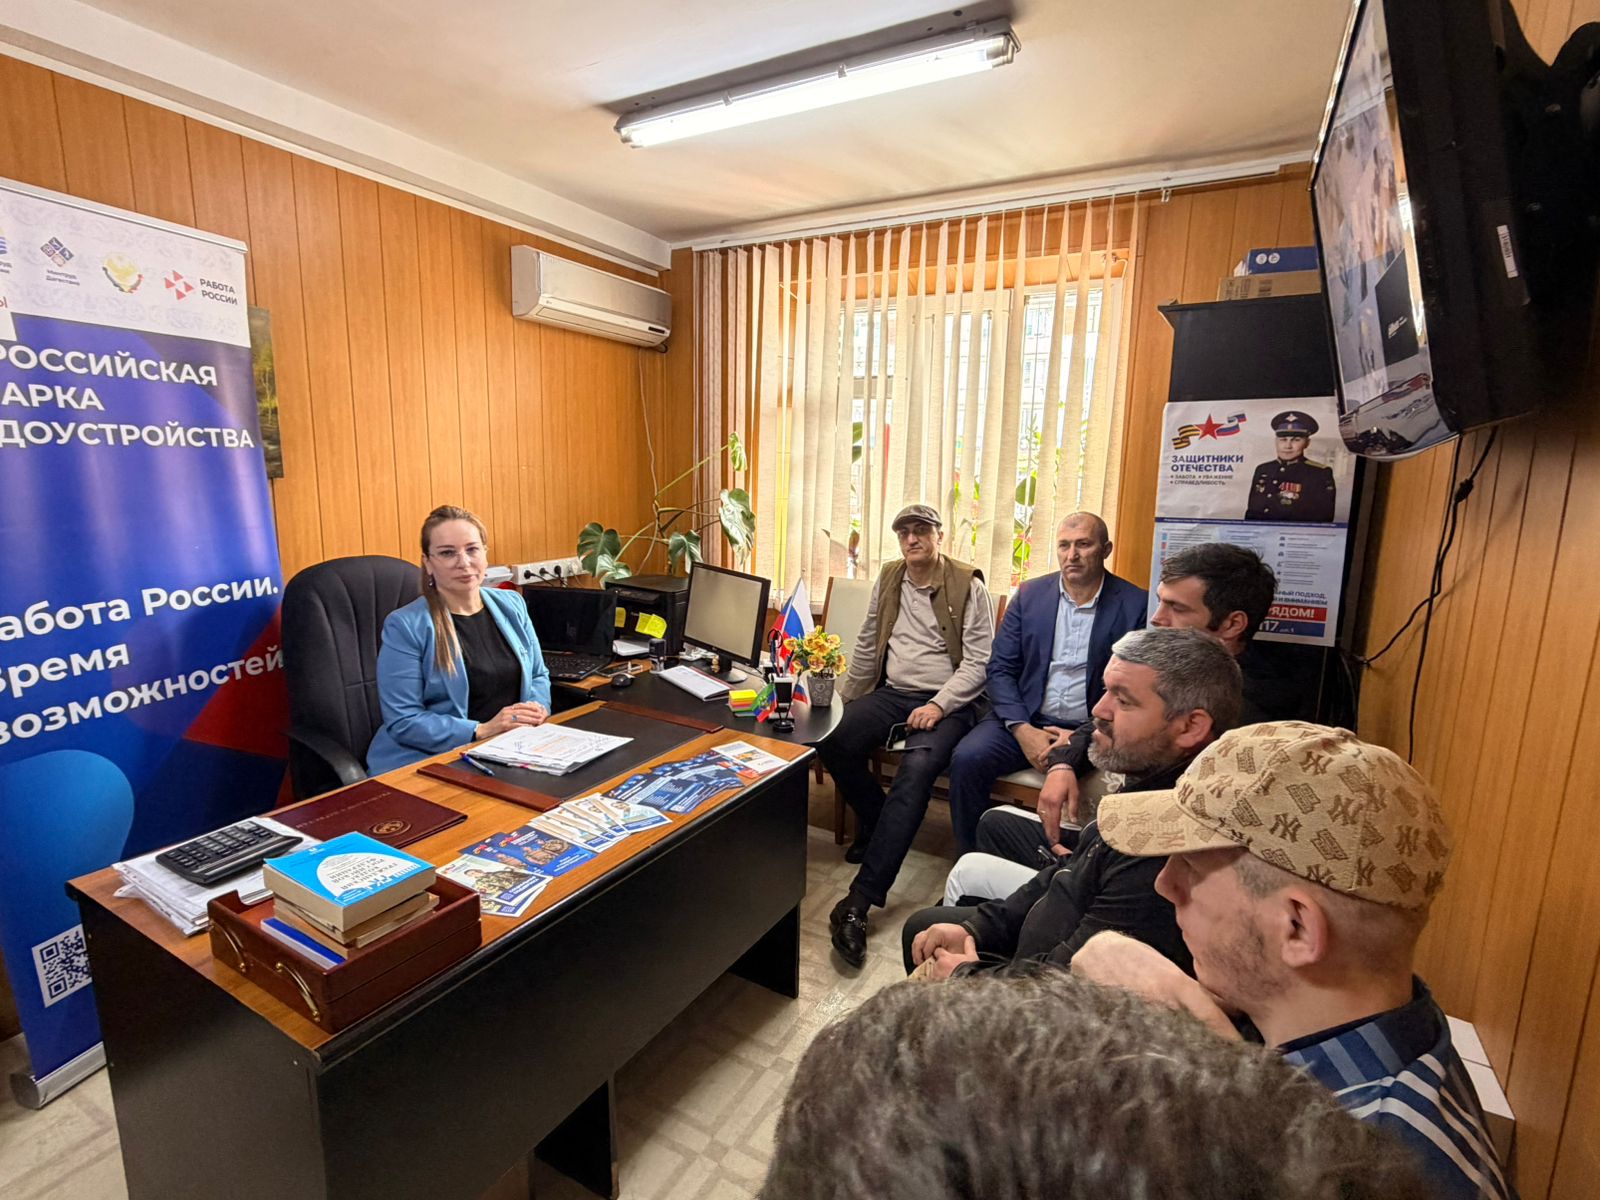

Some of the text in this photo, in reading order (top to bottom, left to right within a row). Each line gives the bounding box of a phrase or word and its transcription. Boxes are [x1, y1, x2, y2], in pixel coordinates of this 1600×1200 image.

[200, 278, 236, 294] РАБОТА
[201, 290, 238, 306] РОССИИ
[0, 344, 218, 387] ОССИЙСКАЯ
[1, 382, 106, 412] АРКА
[0, 419, 255, 449] ДОУСТРОЙСТВА
[1170, 464, 1234, 472] ОТЕЧЕСТВА
[1171, 454, 1244, 464] ЗАЩИТНИКИ
[140, 575, 279, 616] России.
[1268, 606, 1315, 619] ЯДОМ!
[1269, 812, 1303, 843] NY
